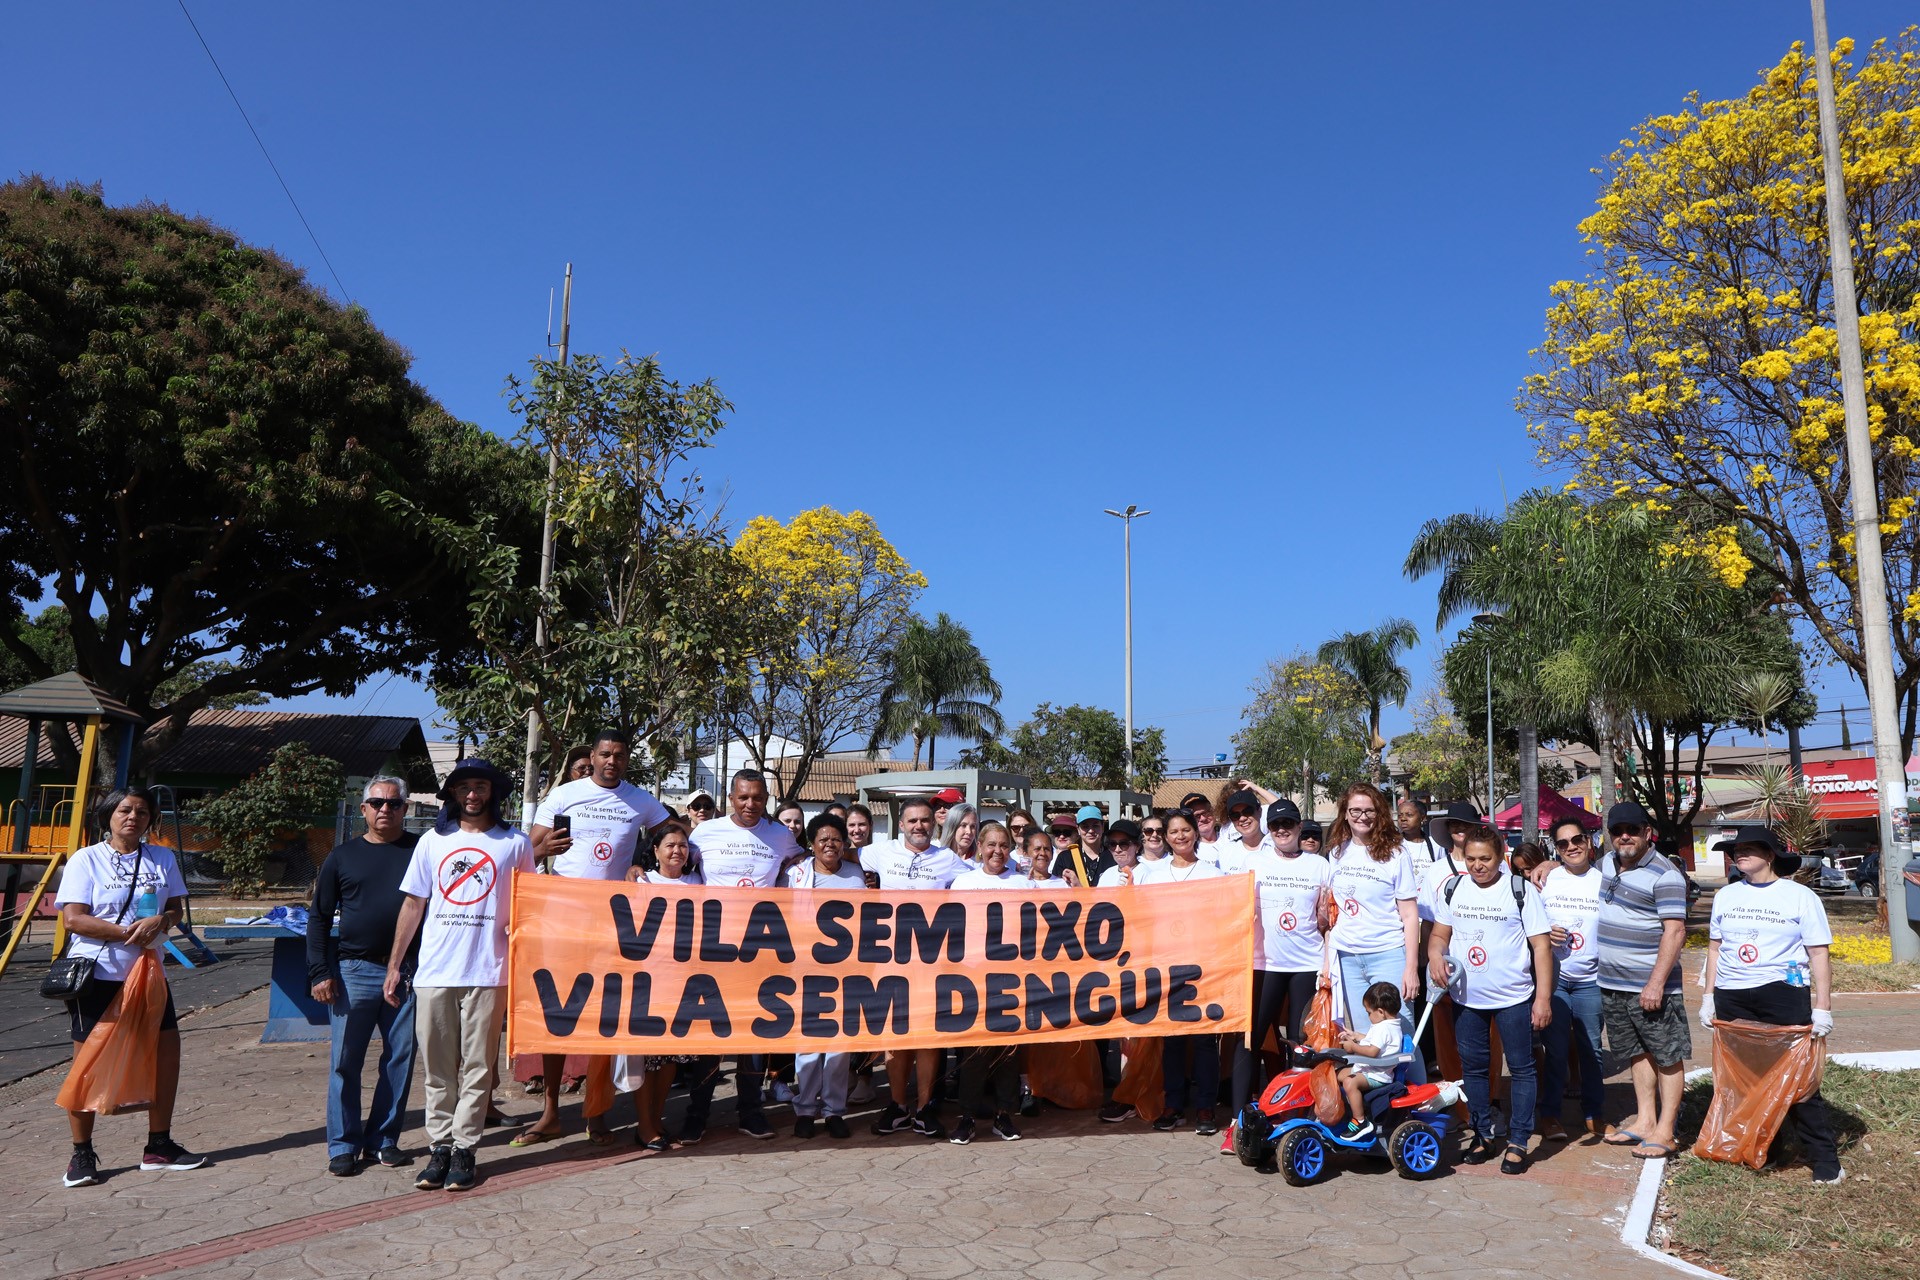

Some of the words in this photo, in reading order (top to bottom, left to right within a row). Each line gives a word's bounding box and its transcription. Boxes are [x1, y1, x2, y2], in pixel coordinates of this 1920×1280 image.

[608, 814, 632, 823] Dengue
[756, 843, 769, 851] Lixo
[751, 850, 774, 859] Dengue
[1356, 872, 1380, 881] Dengue
[1290, 882, 1315, 890] Dengue
[1480, 913, 1508, 922] Dengue
[1755, 915, 1786, 924] Dengue
[609, 893, 796, 964] VILA
[812, 899, 967, 965] SEM
[985, 901, 1131, 967] LIXO,
[532, 968, 732, 1038] VILA
[752, 974, 910, 1039] SEM
[934, 964, 1225, 1033] DENGUE.
